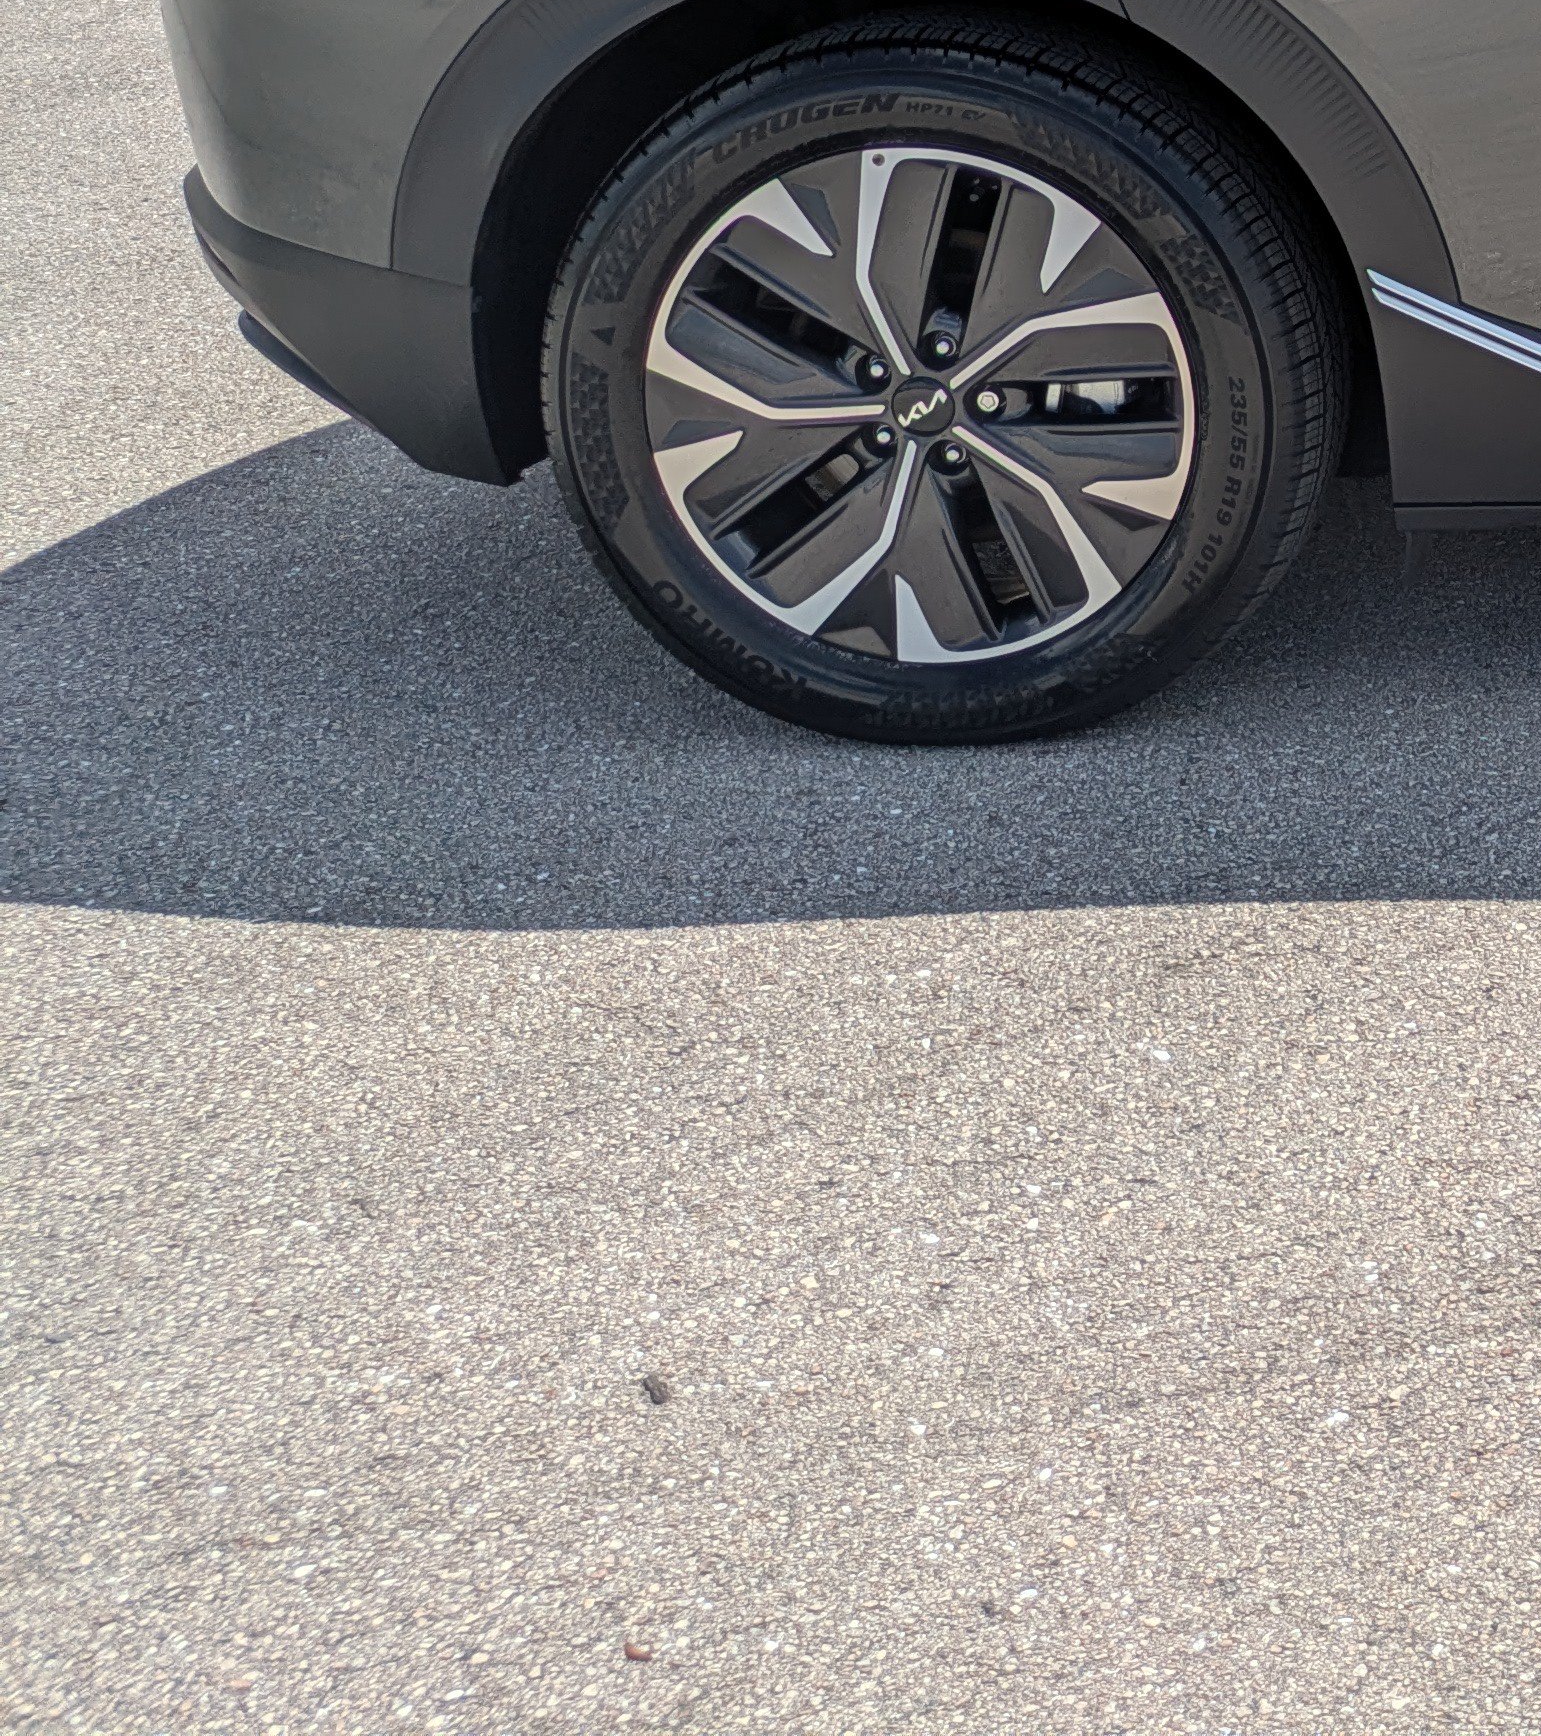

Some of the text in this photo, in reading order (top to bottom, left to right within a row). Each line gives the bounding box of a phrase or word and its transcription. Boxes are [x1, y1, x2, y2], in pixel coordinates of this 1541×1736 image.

[904, 100, 953, 118] HP71
[1182, 376, 1249, 595] 235/55 R19 101H
[651, 579, 808, 702] KUMHO
